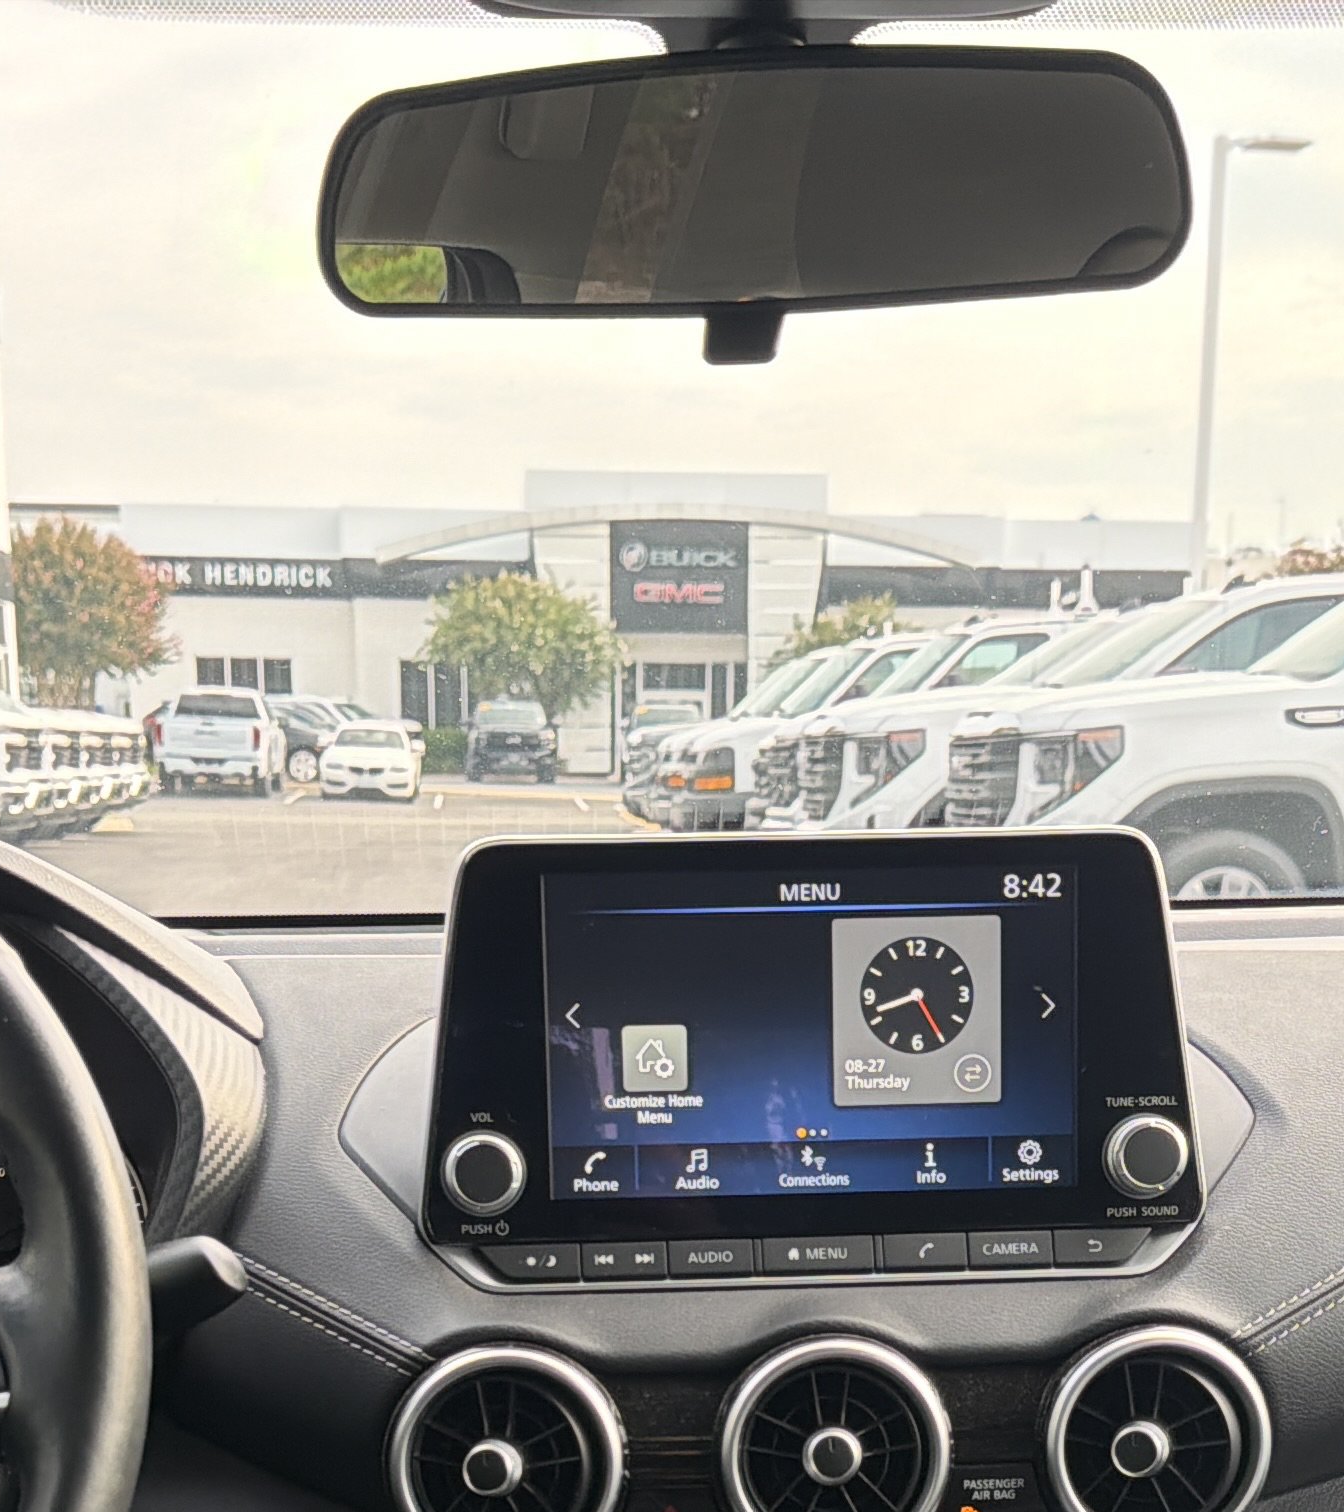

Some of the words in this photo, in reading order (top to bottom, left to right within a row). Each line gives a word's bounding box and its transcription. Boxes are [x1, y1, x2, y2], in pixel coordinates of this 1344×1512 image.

[649, 550, 736, 568] BUICK
[205, 562, 332, 588] HENDRICK
[633, 582, 725, 604] GMC
[780, 883, 841, 901] MENU
[1003, 873, 1062, 899] 8:42
[906, 940, 927, 957] 12
[863, 988, 876, 1006] 9
[958, 986, 970, 1004] 3
[911, 1035, 924, 1051] 6
[844, 1059, 885, 1074] 08-27
[845, 1075, 910, 1090] Thursday
[605, 1095, 665, 1109] Customize
[668, 1095, 704, 1107] Home
[470, 1112, 494, 1123] VOL
[637, 1111, 673, 1124] Menu
[778, 1172, 850, 1188] Connections
[916, 1170, 947, 1184] Info
[1002, 1168, 1060, 1183] Settings
[573, 1178, 619, 1192] Phone
[675, 1176, 720, 1191] Audio
[1106, 1207, 1137, 1218] PUSH
[1141, 1205, 1179, 1217] SOUND
[461, 1223, 493, 1235] PUSH
[806, 1247, 848, 1260] MENU
[982, 1242, 1039, 1256] CAMERA
[688, 1250, 733, 1264] AUDIO
[963, 1478, 1025, 1490] PASSENGER
[971, 1490, 991, 1500] AIR
[993, 1489, 1016, 1500] BAG
